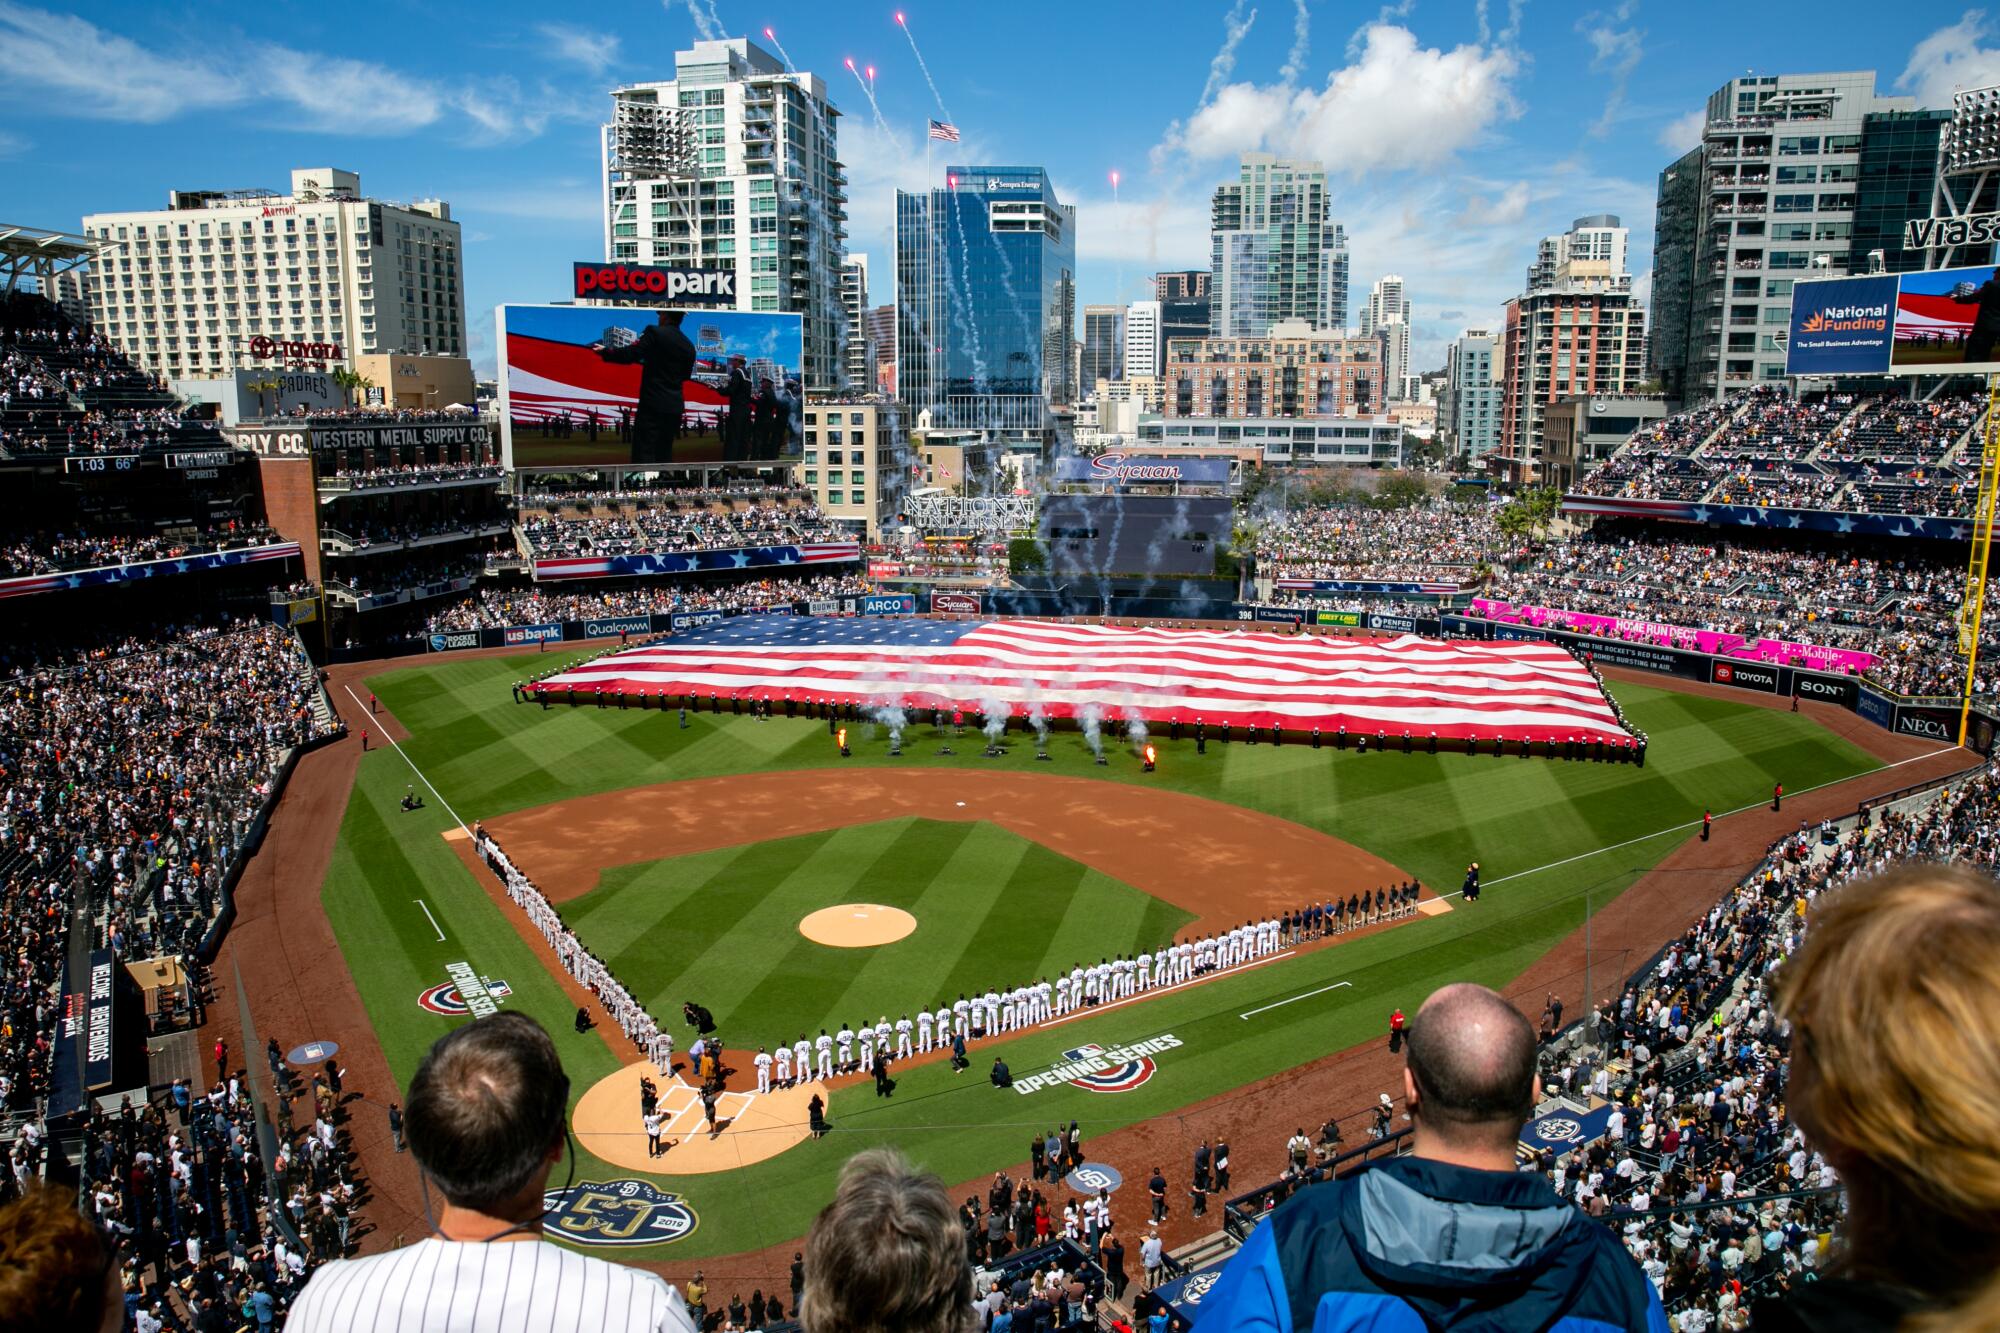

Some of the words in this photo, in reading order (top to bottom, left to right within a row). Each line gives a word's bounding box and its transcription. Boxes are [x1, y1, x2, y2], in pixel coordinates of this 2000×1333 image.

[1021, 181, 1041, 190] Energy
[262, 206, 296, 217] Marriott
[576, 265, 667, 297] petco
[667, 271, 733, 299] park
[1825, 304, 1888, 319] National
[1823, 319, 1886, 332] Funding
[280, 341, 343, 360] TOYOTA
[1851, 339, 1884, 347] Advantage
[279, 375, 328, 399] PADRES
[278, 433, 310, 455] CO.
[311, 430, 375, 449] WESTERN
[380, 428, 421, 446] METAL
[423, 427, 466, 445] SUPPLY
[470, 427, 488, 443] CO.
[77, 457, 105, 471] 1:03
[1090, 452, 1183, 487] Sycuan
[866, 600, 901, 611] ARCO
[936, 596, 974, 612] Sycuan
[1238, 610, 1252, 620] 396
[1382, 618, 1412, 627] PENFED
[587, 622, 649, 636] Qualcomm
[1616, 619, 1645, 634] HOME
[1646, 623, 1668, 637] RUN
[1669, 627, 1698, 640] DECK
[447, 633, 477, 642] ROCKET
[447, 640, 478, 648] LEAGUE
[1577, 641, 1590, 649] AND
[1591, 643, 1603, 651] THE
[1604, 645, 1636, 656] ROCKET'S
[1637, 650, 1651, 659] RED
[1593, 652, 1615, 662] BOMBS
[1616, 656, 1649, 668] BURSTING
[1734, 670, 1773, 685] TOYOTA
[1859, 697, 1879, 715] petco
[1901, 716, 1950, 738] NECA
[91, 962, 111, 1001] WELCOME
[445, 961, 488, 999] OPENING
[466, 995, 499, 1020] SER
[88, 1004, 110, 1062] BIENVENIDOS
[1012, 1057, 1112, 1095] OPENING
[1105, 1033, 1184, 1065] SERIES
[658, 1217, 684, 1228] 2019
